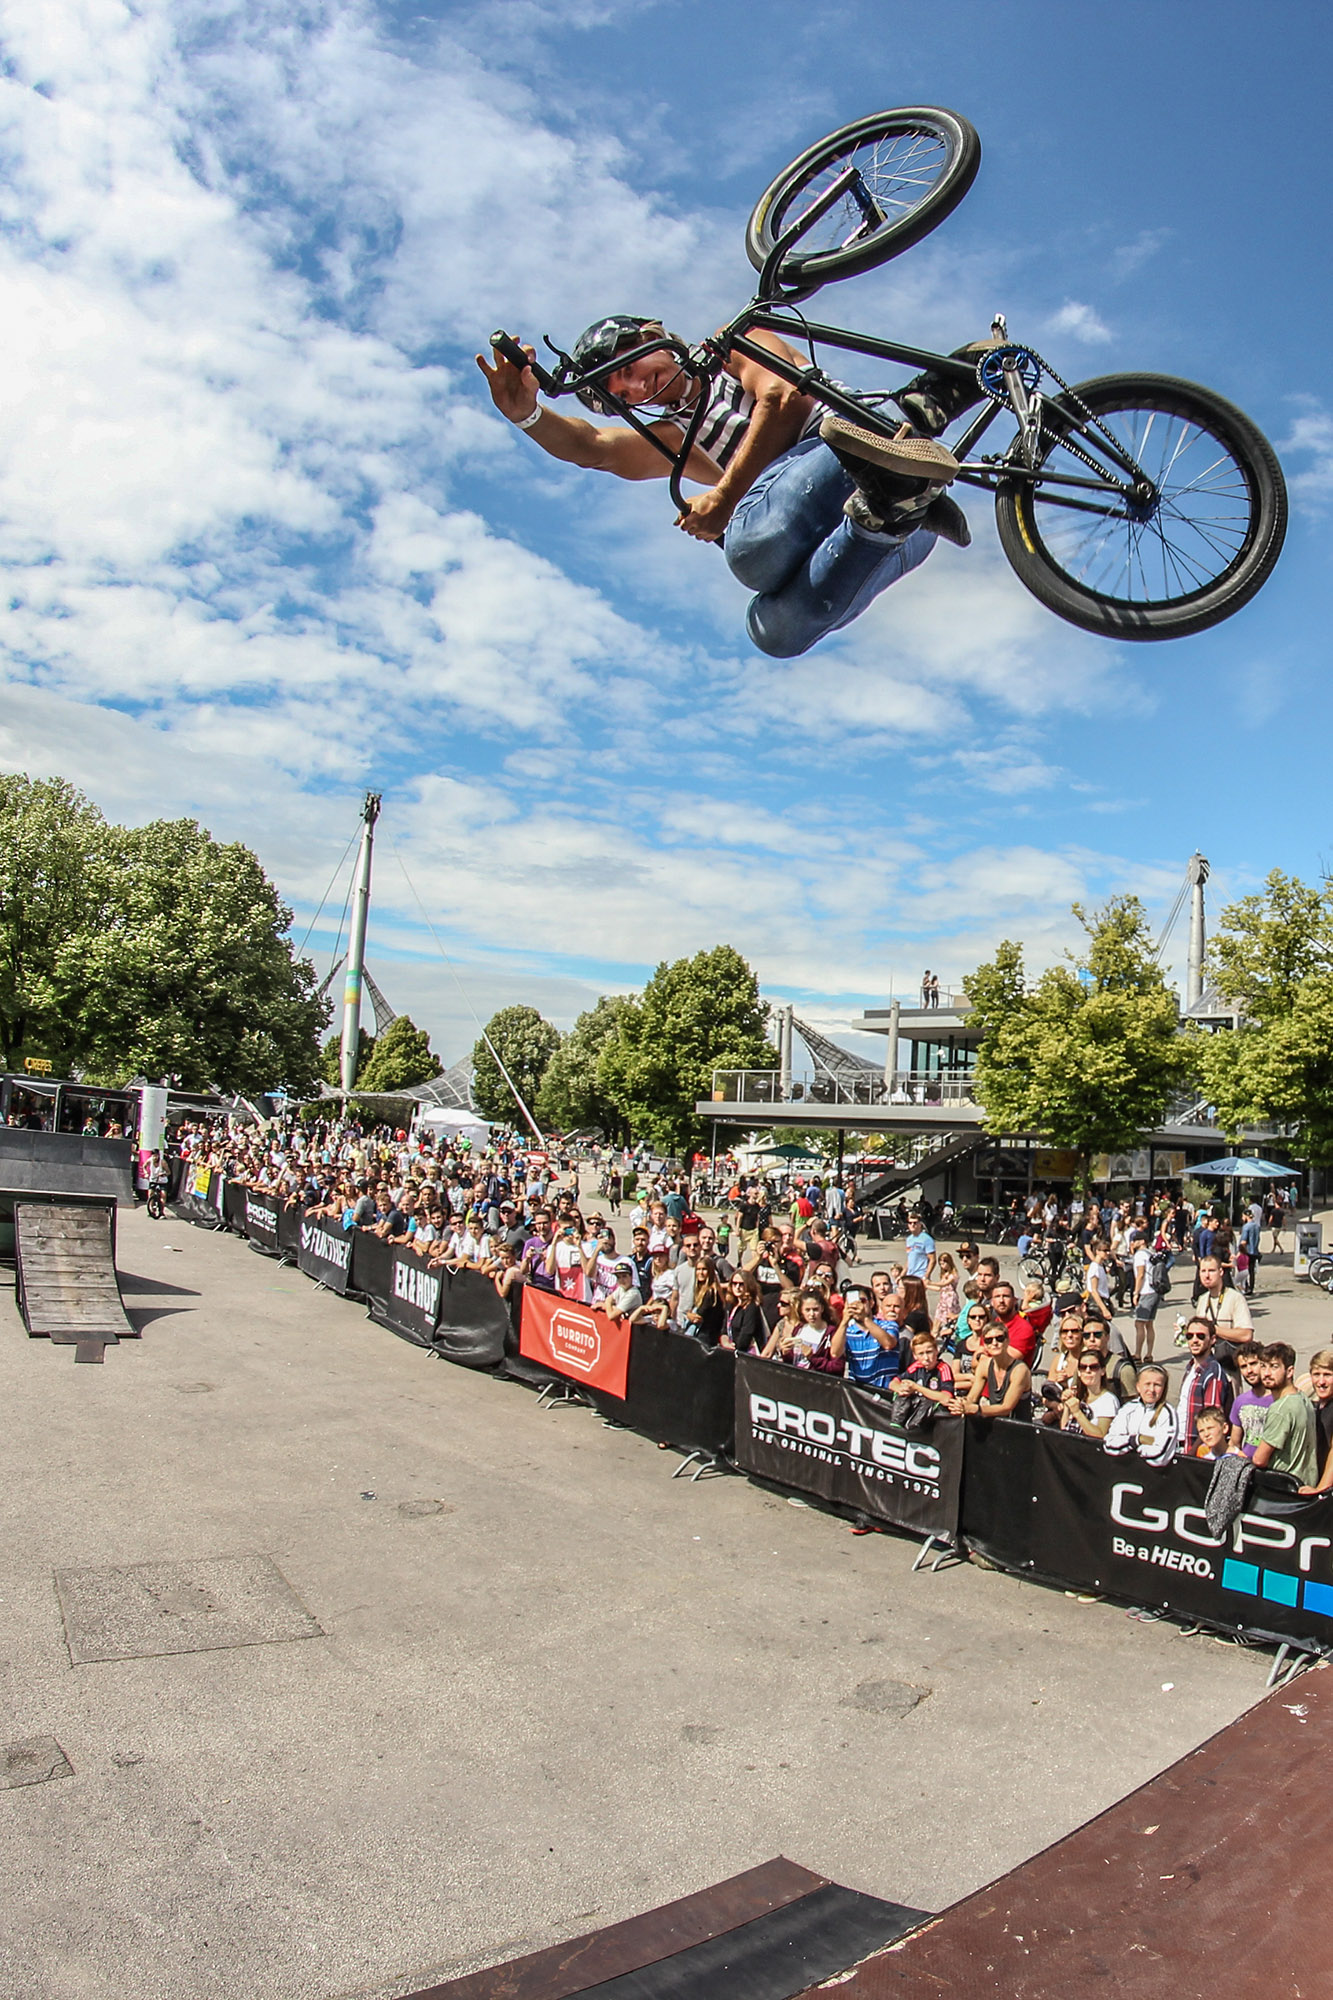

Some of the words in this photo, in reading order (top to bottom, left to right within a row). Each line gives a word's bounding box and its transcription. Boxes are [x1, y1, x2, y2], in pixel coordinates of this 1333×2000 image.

[557, 1325, 596, 1349] BURRITO
[749, 1393, 941, 1479] PRO-TEC
[752, 1428, 774, 1444] THE
[781, 1438, 842, 1466] ORIGINAL
[850, 1461, 894, 1484] SINCE
[904, 1479, 941, 1500] 1973
[1110, 1482, 1333, 1572] GoPr
[1112, 1536, 1136, 1558] Be
[1138, 1546, 1149, 1561] a
[1150, 1545, 1216, 1580] HERO.
